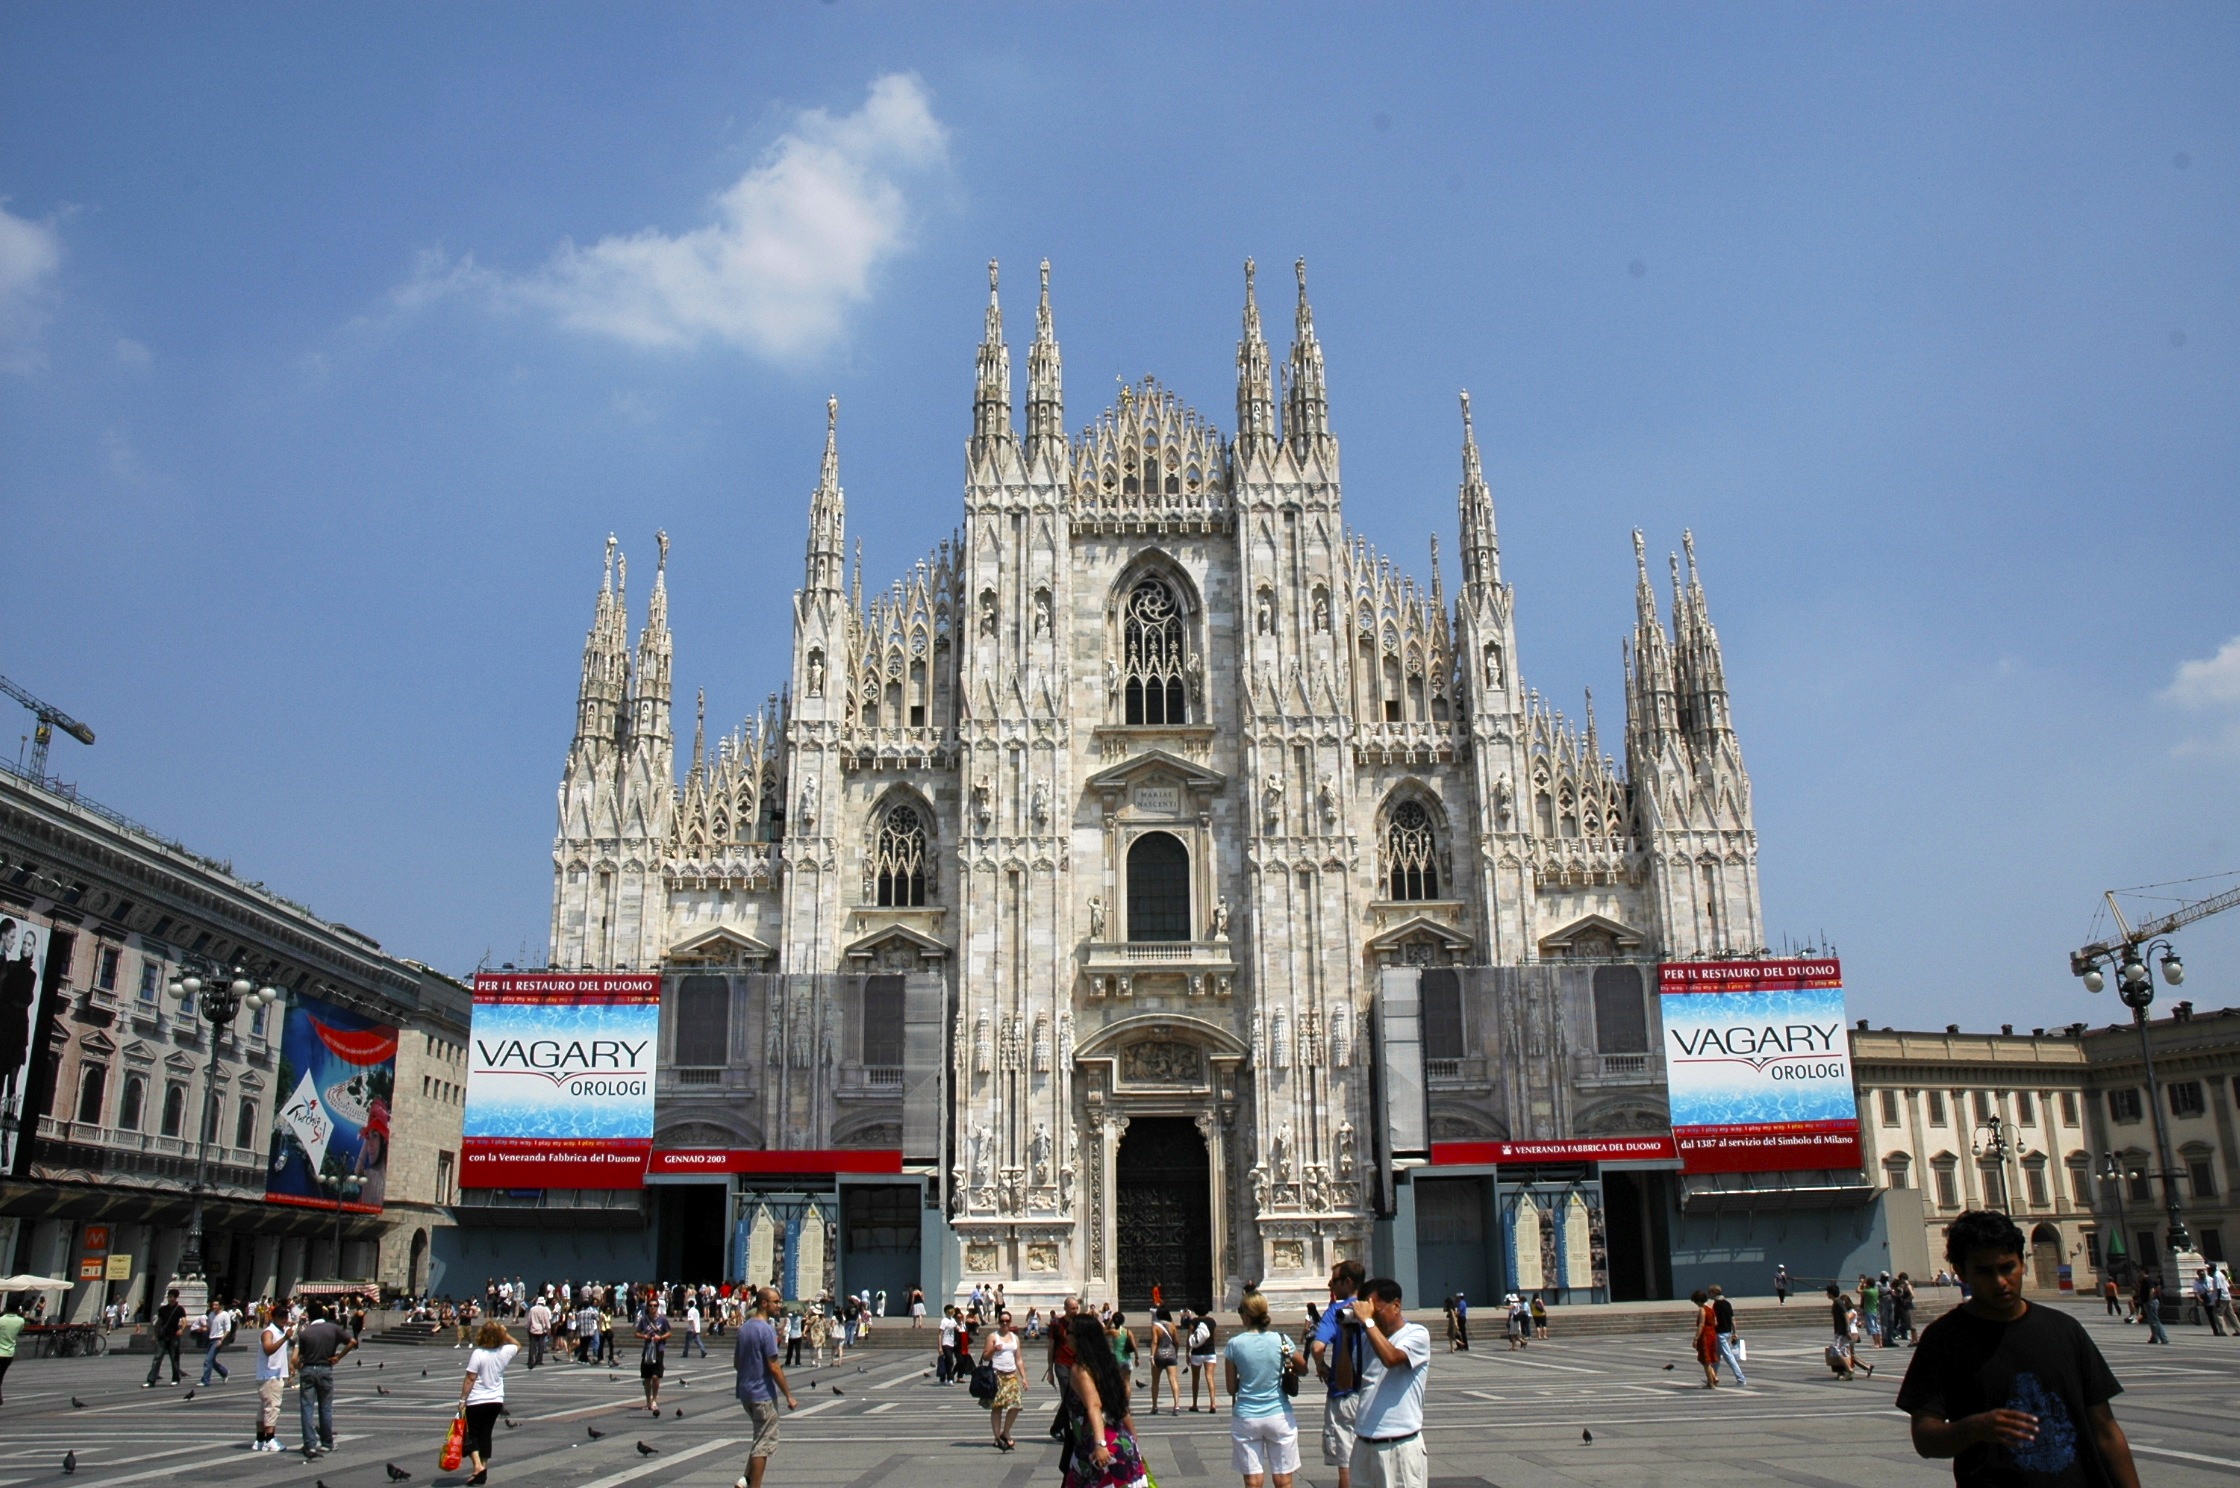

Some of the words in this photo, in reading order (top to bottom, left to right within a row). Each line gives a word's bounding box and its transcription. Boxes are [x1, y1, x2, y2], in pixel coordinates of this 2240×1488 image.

[1664, 969, 1685, 979] PER
[1688, 969, 1698, 979] IL
[1702, 968, 1760, 979] RESTAURO
[1764, 967, 1784, 977] DEL
[1788, 965, 1835, 976] DUOMO
[478, 981, 498, 991] PER
[502, 981, 511, 991] IL
[516, 981, 575, 991] RESTAURO
[579, 981, 600, 991] DEL
[603, 981, 653, 991] DUOMO
[1671, 1023, 1839, 1056] VAGARY
[477, 1039, 649, 1068] VAGARY
[1771, 1063, 1845, 1081] OROLOGI
[570, 1080, 646, 1096] OROLOGI
[1515, 1145, 1566, 1154] VENERANDA
[1568, 1144, 1608, 1153] FABBRICA
[1609, 1143, 1625, 1151] DEL
[1626, 1142, 1661, 1151] DUOMO
[1681, 1139, 1695, 1149] dal
[1696, 1139, 1717, 1148] 1387
[1719, 1138, 1727, 1147] al
[1728, 1138, 1761, 1147] servizio
[1763, 1137, 1776, 1146] del
[1778, 1135, 1812, 1146] Simbolo
[1813, 1135, 1822, 1144] di
[1823, 1135, 1853, 1144] Milano
[469, 1154, 486, 1162] con
[488, 1153, 497, 1162] la
[499, 1153, 546, 1162] Veneranda
[549, 1153, 587, 1162] Fabbrica
[590, 1153, 604, 1163] del
[607, 1154, 641, 1163] Duomo
[664, 1155, 705, 1163] GENNAIO
[706, 1155, 726, 1163] 2003
[739, 1223, 743, 1233] 1
[788, 1223, 795, 1234] 2
[87, 1231, 105, 1246] M
